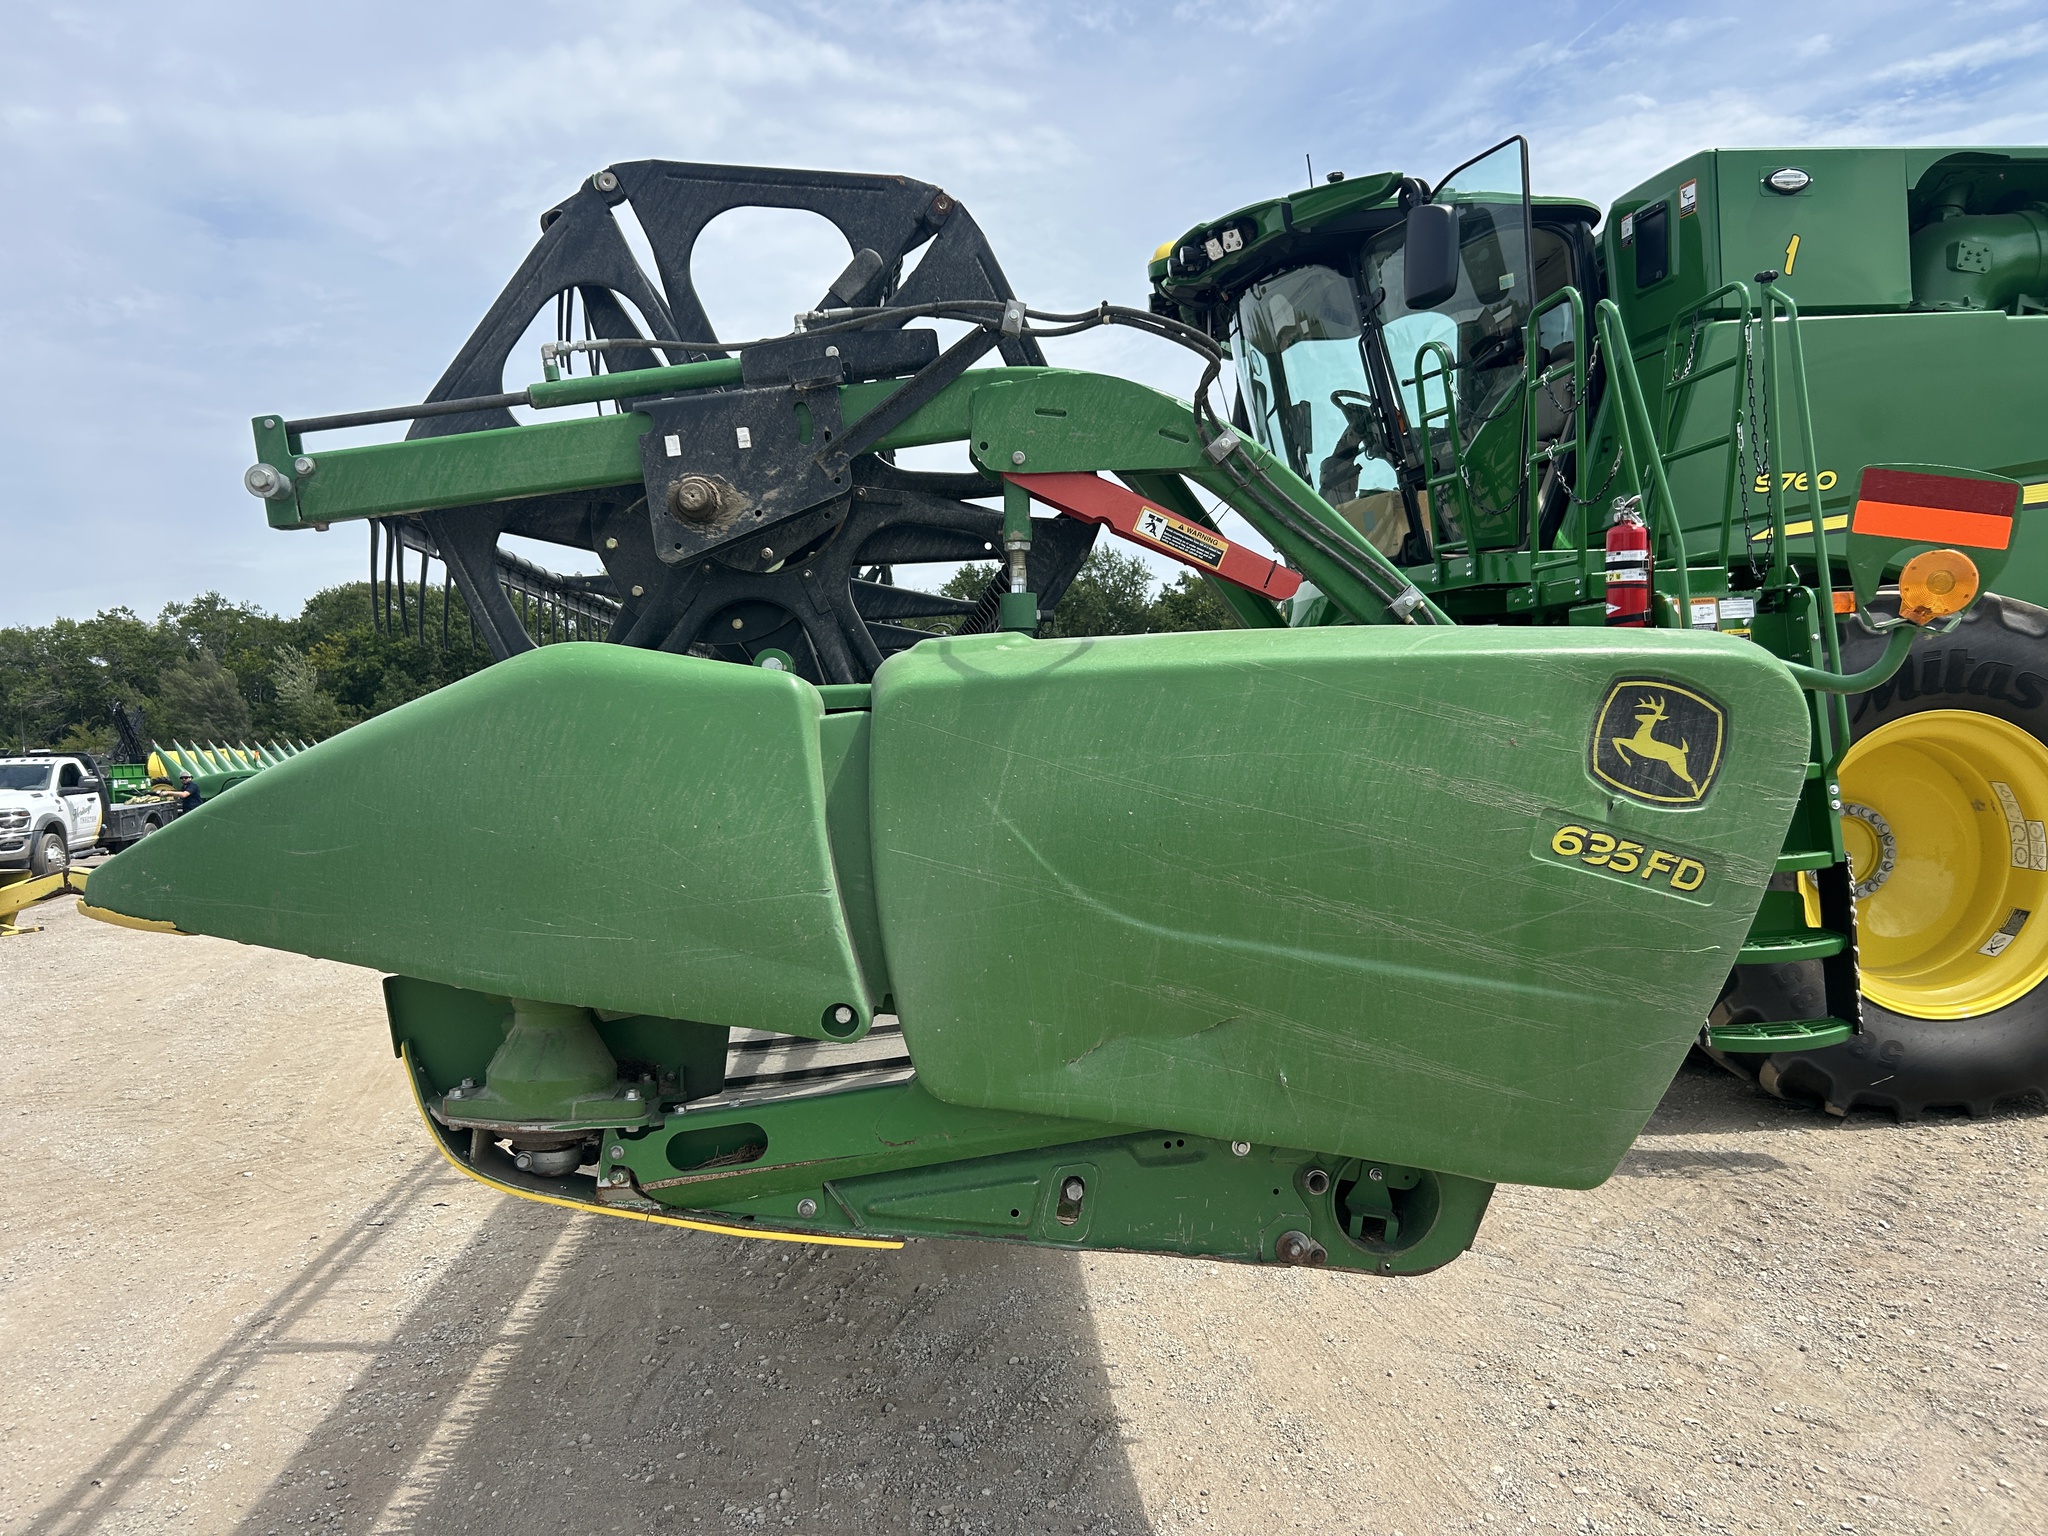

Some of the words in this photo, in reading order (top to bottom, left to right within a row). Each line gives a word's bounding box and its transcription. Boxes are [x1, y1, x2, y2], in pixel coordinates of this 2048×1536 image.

[1784, 233, 1801, 276] 1
[1186, 526, 1219, 546] WARNING
[1853, 648, 2048, 725] Mitas
